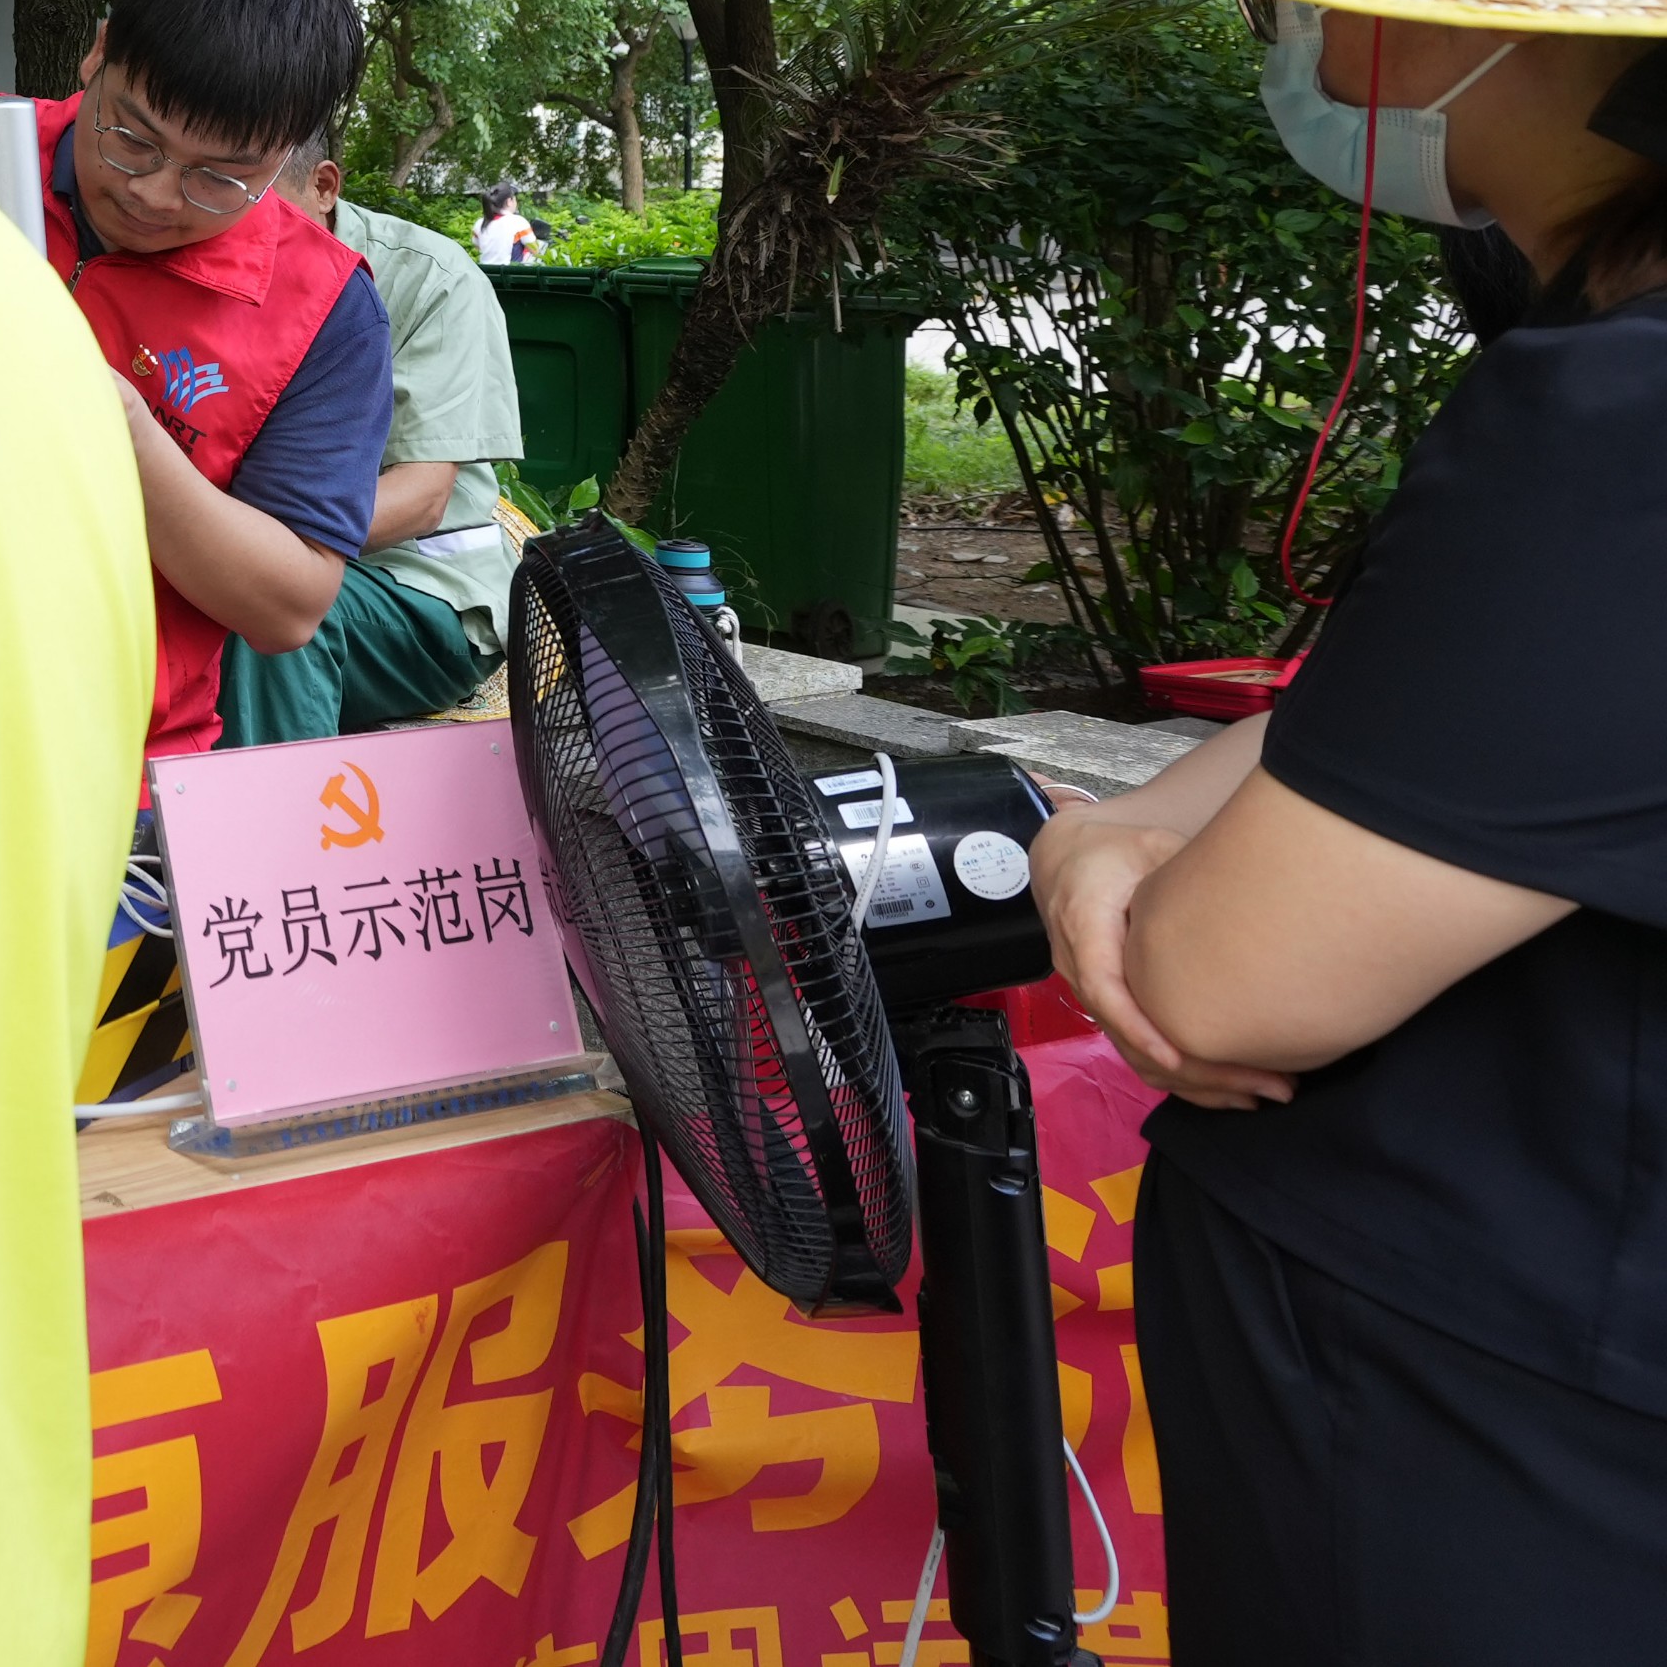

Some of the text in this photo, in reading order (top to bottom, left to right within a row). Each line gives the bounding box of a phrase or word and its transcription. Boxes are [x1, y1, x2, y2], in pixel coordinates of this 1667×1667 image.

[202, 857, 534, 989] 党员示范岗
